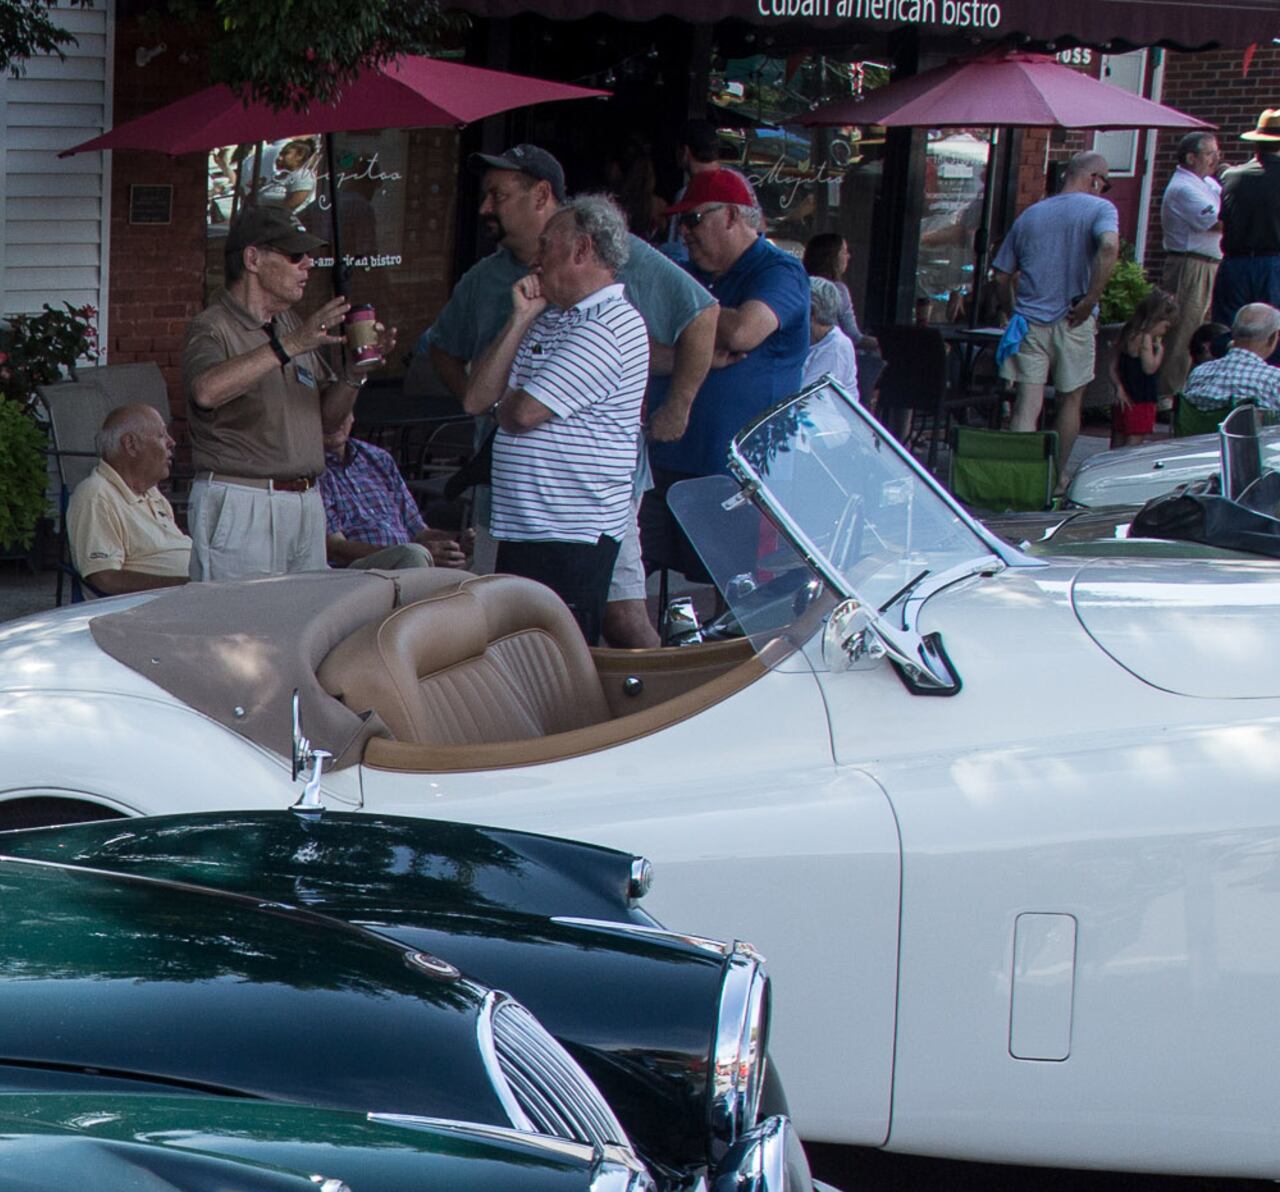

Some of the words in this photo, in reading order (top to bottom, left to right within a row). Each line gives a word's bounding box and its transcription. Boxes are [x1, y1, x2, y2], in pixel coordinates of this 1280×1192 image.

[837, 0, 936, 24] american
[942, 0, 1001, 28] bistro
[370, 253, 402, 268] bistro
